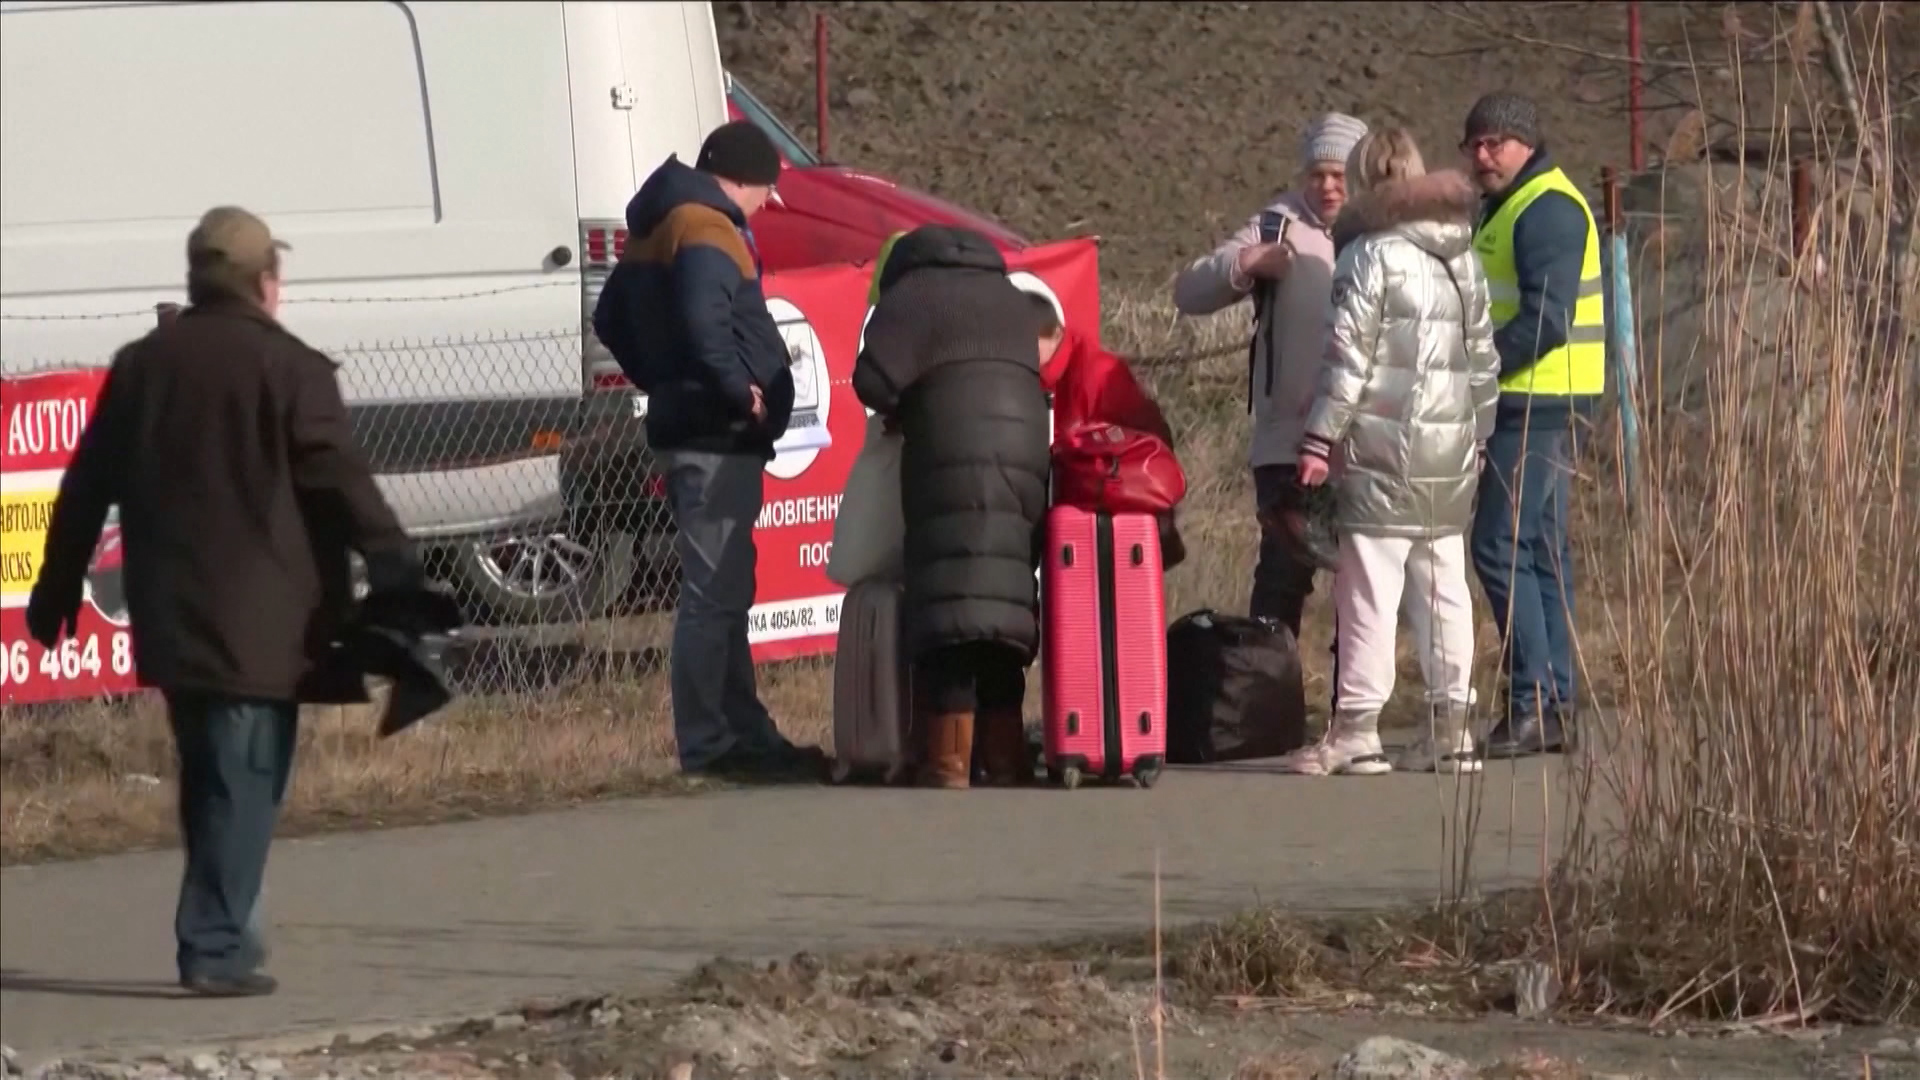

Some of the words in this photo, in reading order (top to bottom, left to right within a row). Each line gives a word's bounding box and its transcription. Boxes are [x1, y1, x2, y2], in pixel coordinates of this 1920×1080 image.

[754, 493, 844, 529] МОВЛЕНН
[39, 632, 102, 680] 464
[111, 631, 132, 676] 8
